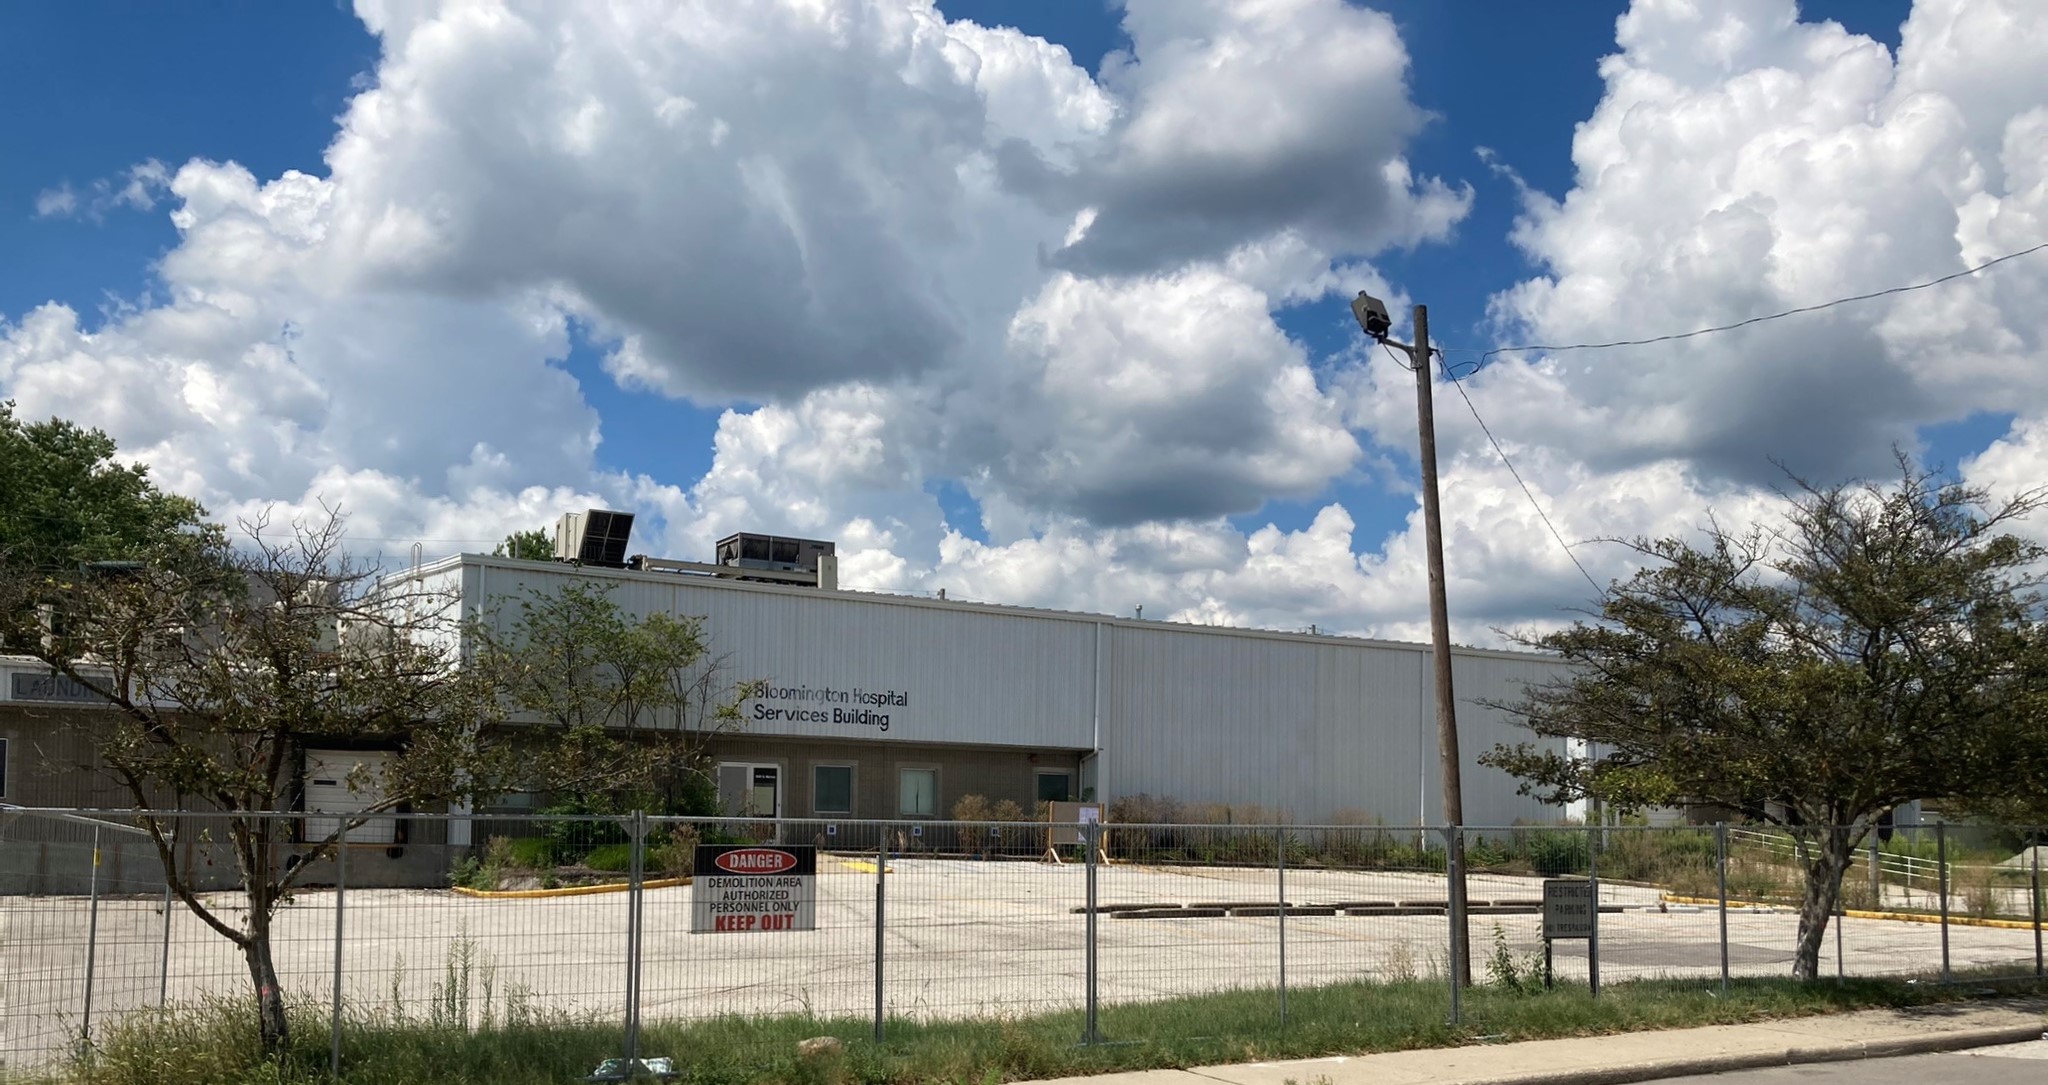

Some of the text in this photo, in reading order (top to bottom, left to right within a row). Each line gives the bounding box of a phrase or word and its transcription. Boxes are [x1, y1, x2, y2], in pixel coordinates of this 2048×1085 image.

[754, 683, 908, 708] Bloomington Hospital
[753, 704, 889, 732] Services Building
[729, 854, 783, 868] DANGER
[708, 877, 802, 888] DEMOLITION AREA
[723, 890, 789, 900] AUTHORIZED
[710, 901, 800, 913] PERSONNEL ONLY
[715, 914, 795, 932] KEEP OUT
